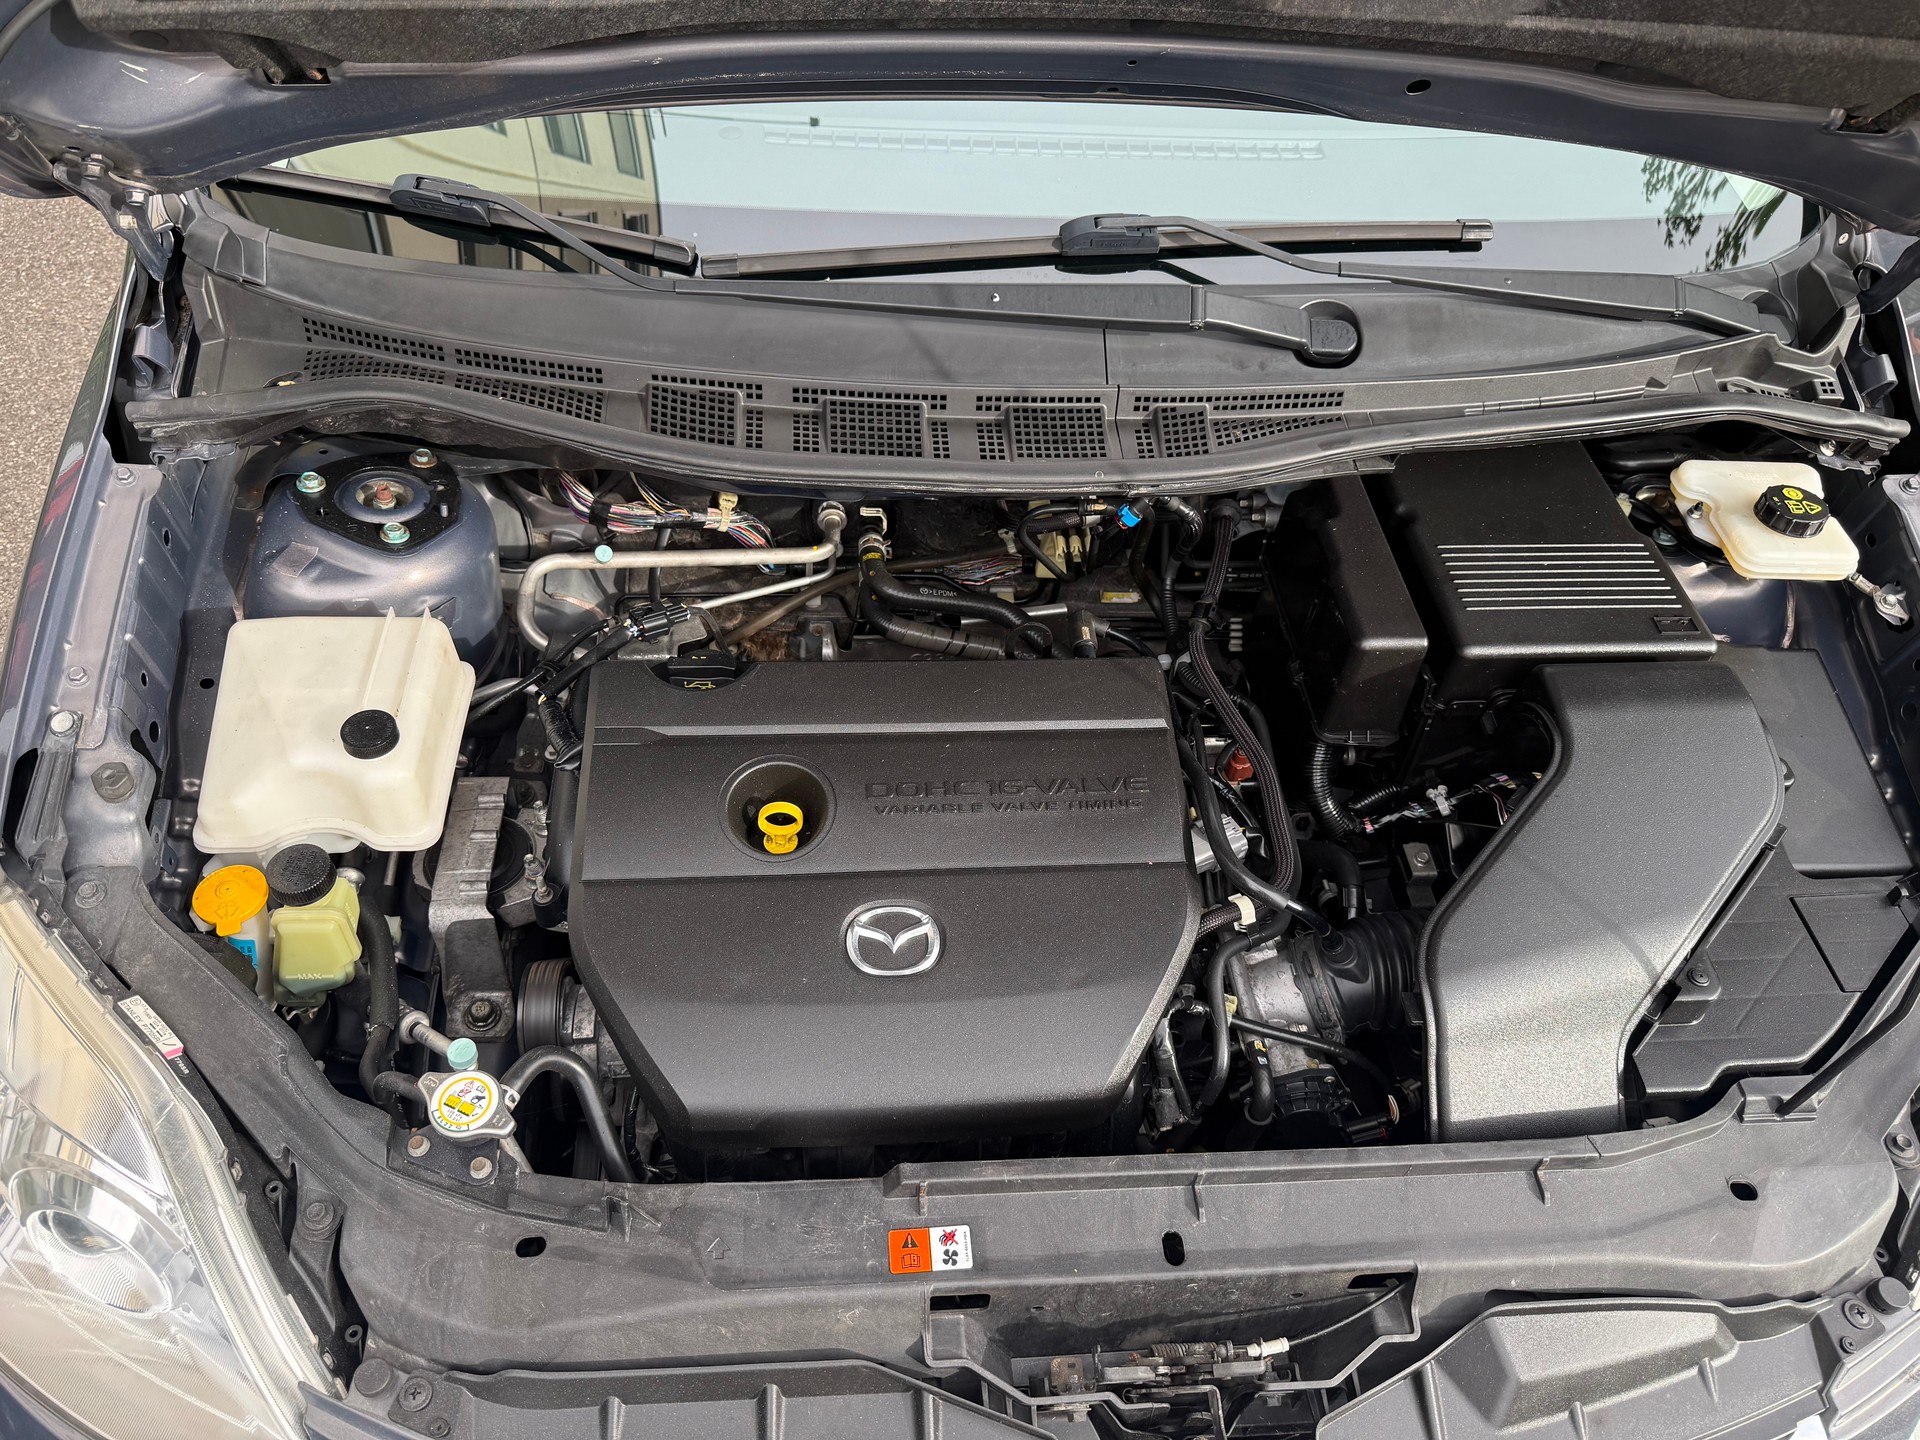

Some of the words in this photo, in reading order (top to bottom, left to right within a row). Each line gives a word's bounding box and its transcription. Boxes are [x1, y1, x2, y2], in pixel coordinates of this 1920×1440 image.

[864, 781, 981, 799] DOHC
[986, 776, 1149, 797] 16-VALVE
[873, 802, 984, 815] VARIABLE
[990, 801, 1059, 813] VALVE
[1065, 799, 1143, 811] TIMING
[297, 972, 322, 980] MAX
[120, 1001, 143, 1024] STANLEY
